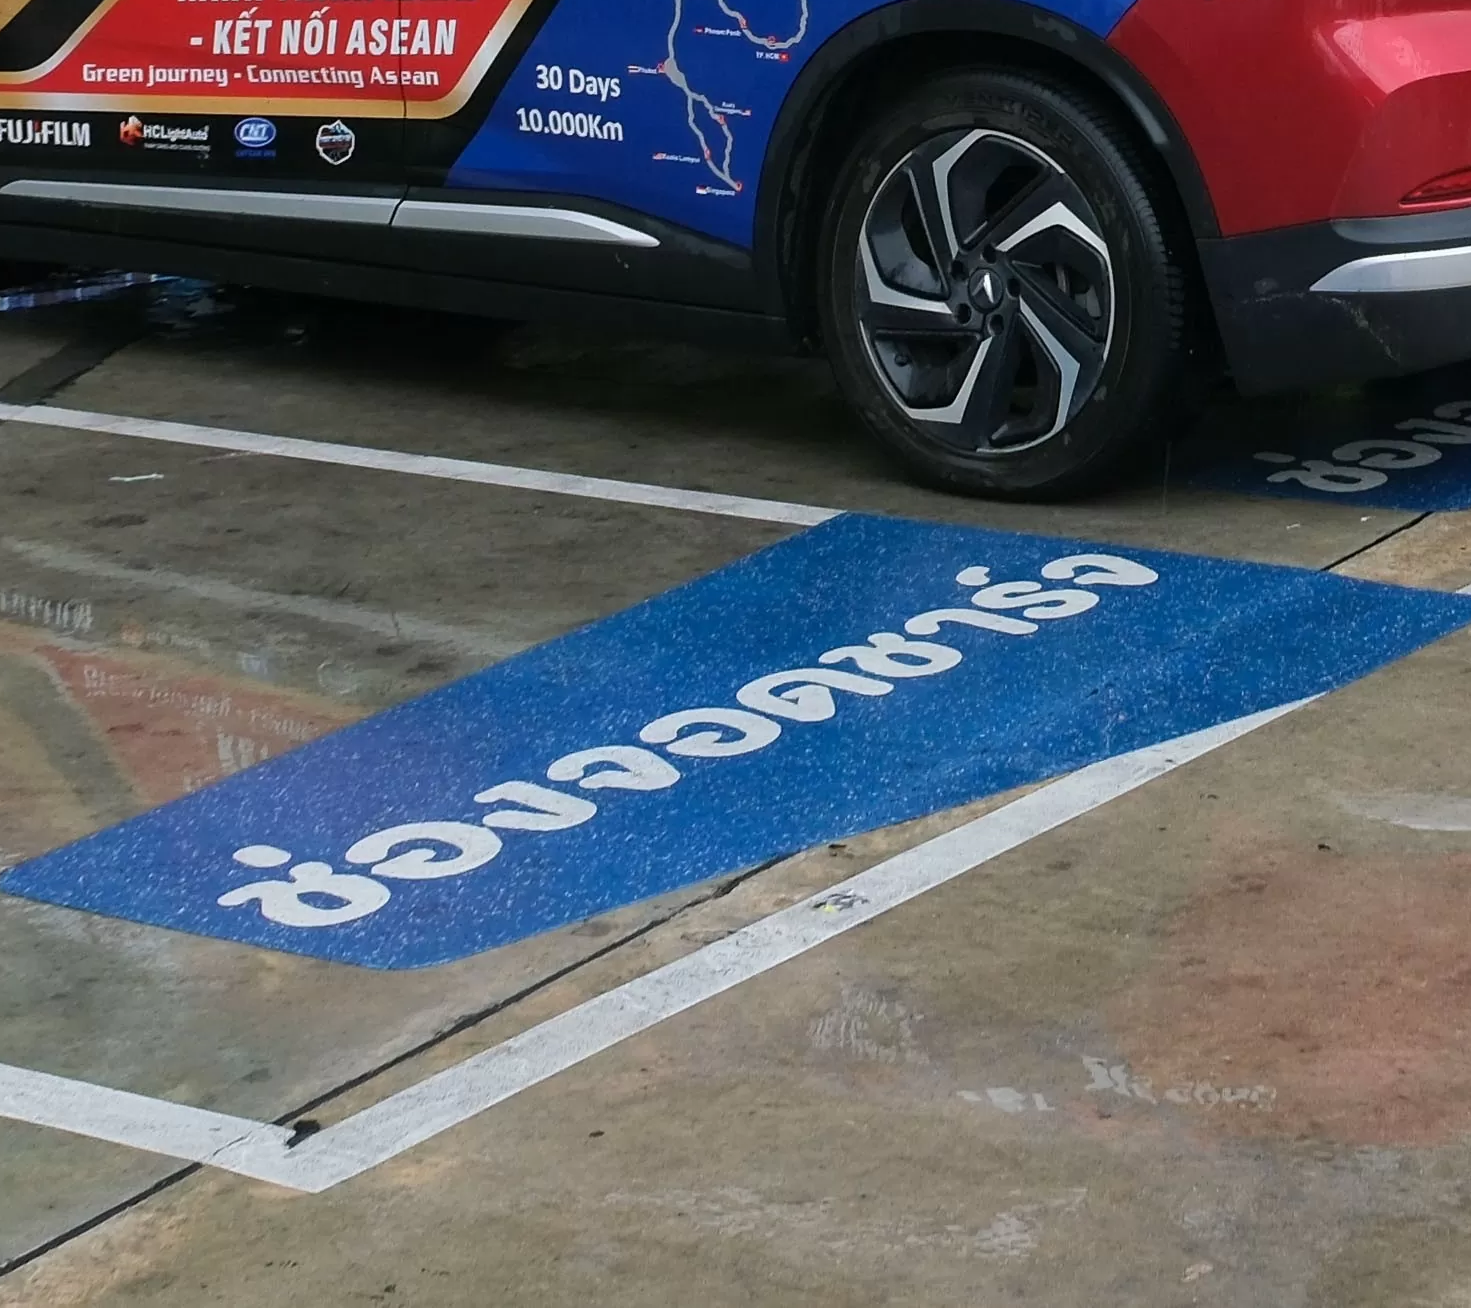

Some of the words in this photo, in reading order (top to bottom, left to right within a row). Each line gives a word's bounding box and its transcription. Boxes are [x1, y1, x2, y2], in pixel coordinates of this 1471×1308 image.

[212, 7, 273, 55] KẾT
[280, 7, 339, 55] NỐI
[345, 19, 457, 56] ASEAN
[82, 63, 144, 83] Green
[247, 64, 365, 89] Connecting
[370, 66, 440, 86] Asean
[536, 64, 563, 91] 30
[569, 67, 621, 101] Days
[516, 107, 624, 142] 10.000Km
[217, 553, 1159, 928] ช่องจอดชาร์จ
